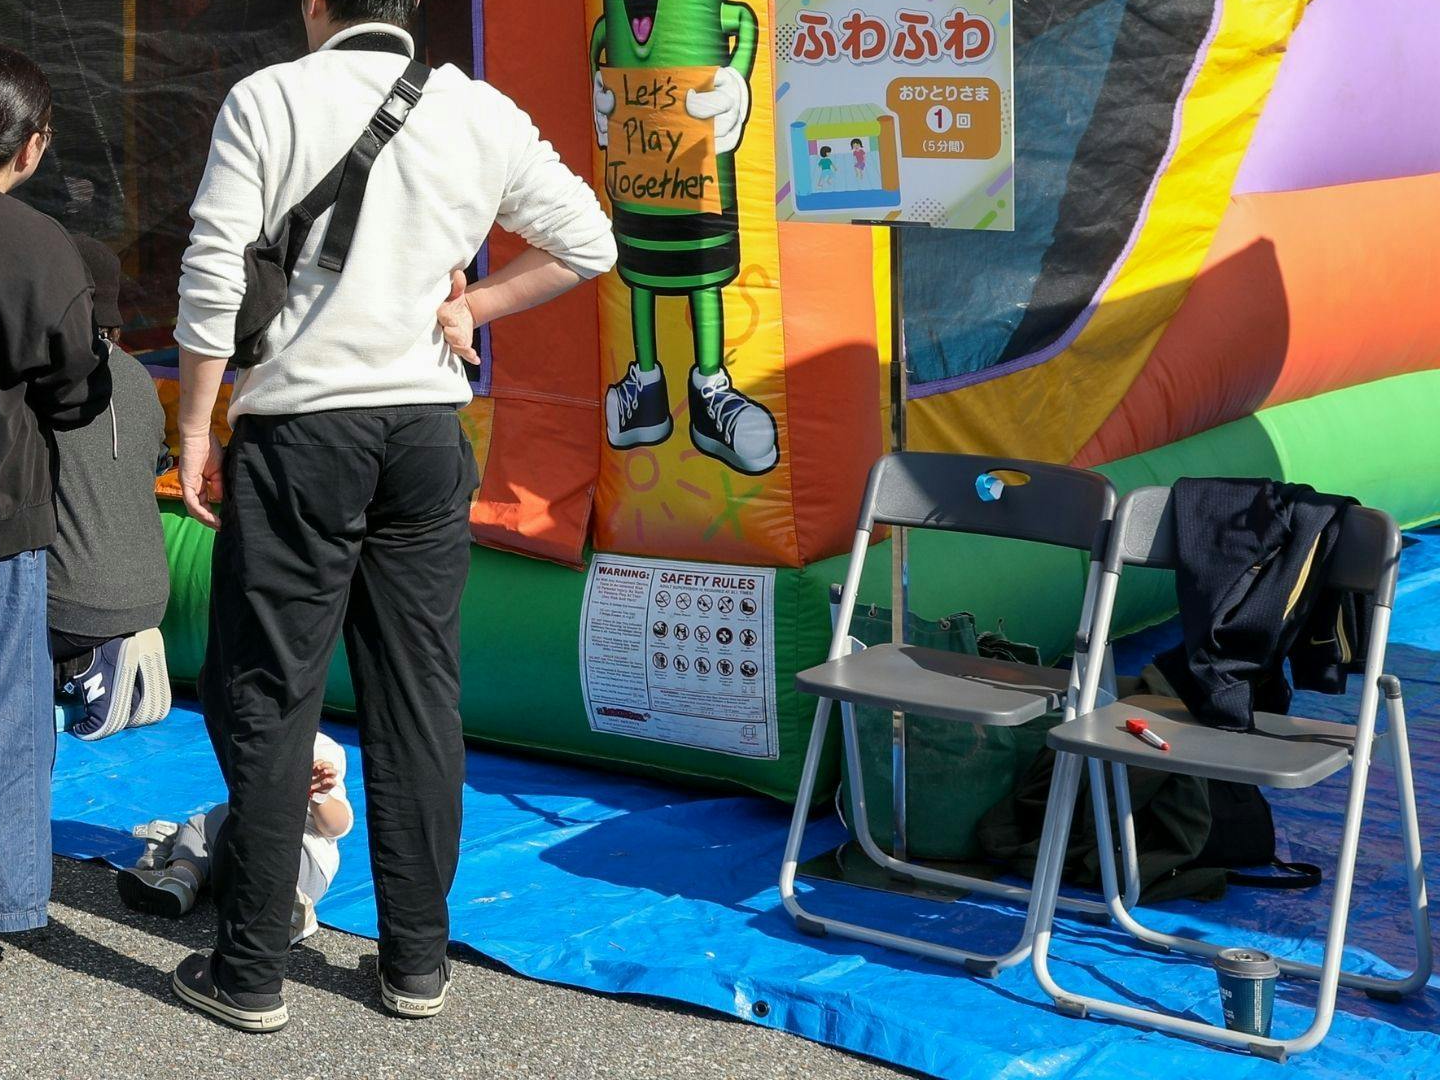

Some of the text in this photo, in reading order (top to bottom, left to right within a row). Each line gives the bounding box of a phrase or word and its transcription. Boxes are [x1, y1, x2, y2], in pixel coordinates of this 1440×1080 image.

[792, 11, 991, 60] ふわふわ
[623, 74, 679, 109] Let's
[899, 86, 989, 101] おひとりさま
[623, 117, 683, 163] Play
[598, 566, 650, 580] WARNING:
[660, 572, 755, 590] SAFETY RULES
[400, 1002, 425, 1011] crocs
